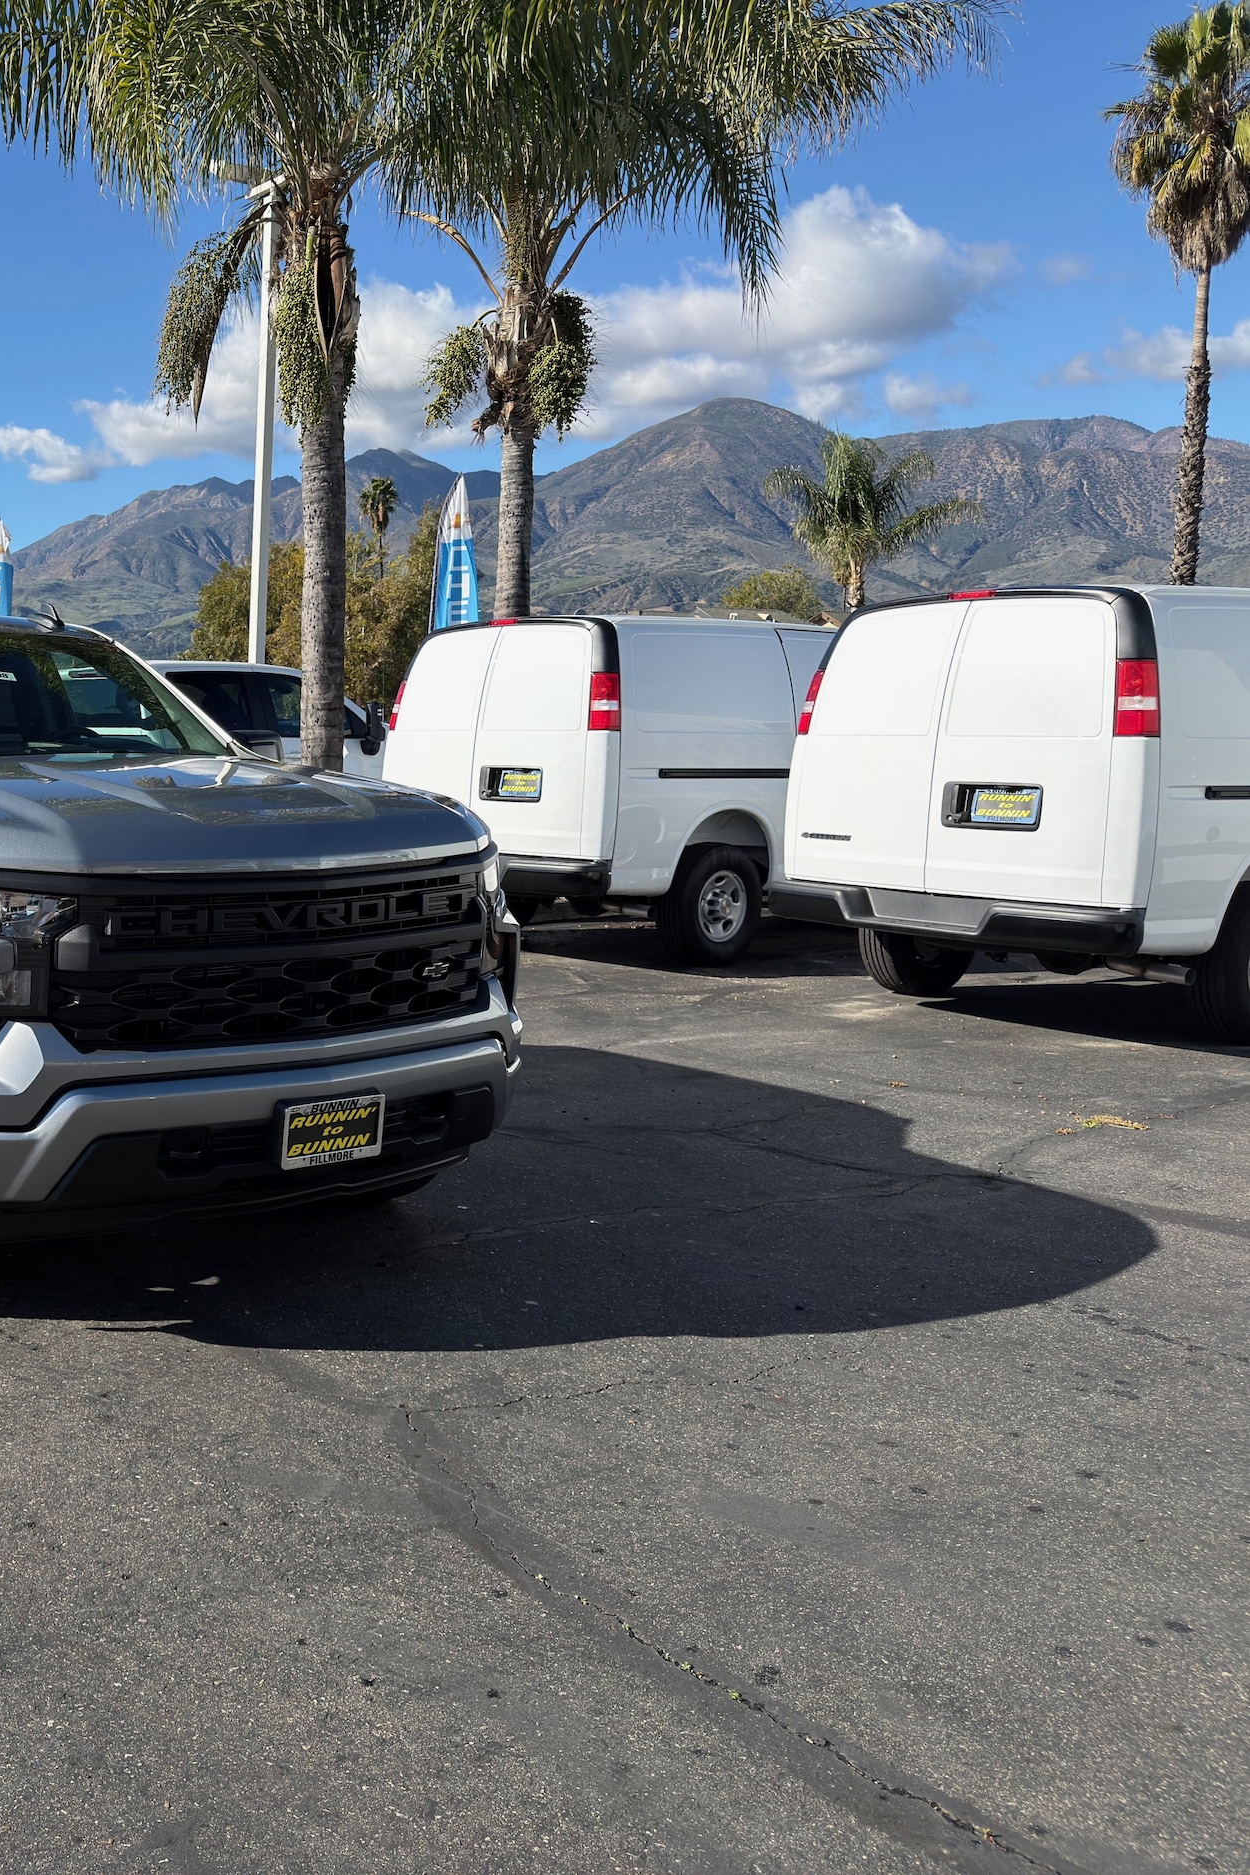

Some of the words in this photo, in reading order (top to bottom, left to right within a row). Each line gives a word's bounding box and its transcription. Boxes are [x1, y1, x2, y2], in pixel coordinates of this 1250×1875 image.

[975, 808, 1031, 817] BUNNIN
[110, 888, 477, 936] CHEVROLET
[311, 1099, 360, 1114] BUNNIN
[290, 1106, 378, 1129] RUNNIN'
[322, 1126, 344, 1136] to
[287, 1133, 371, 1157] BUNNIN
[310, 1150, 355, 1165] FILLMORE
